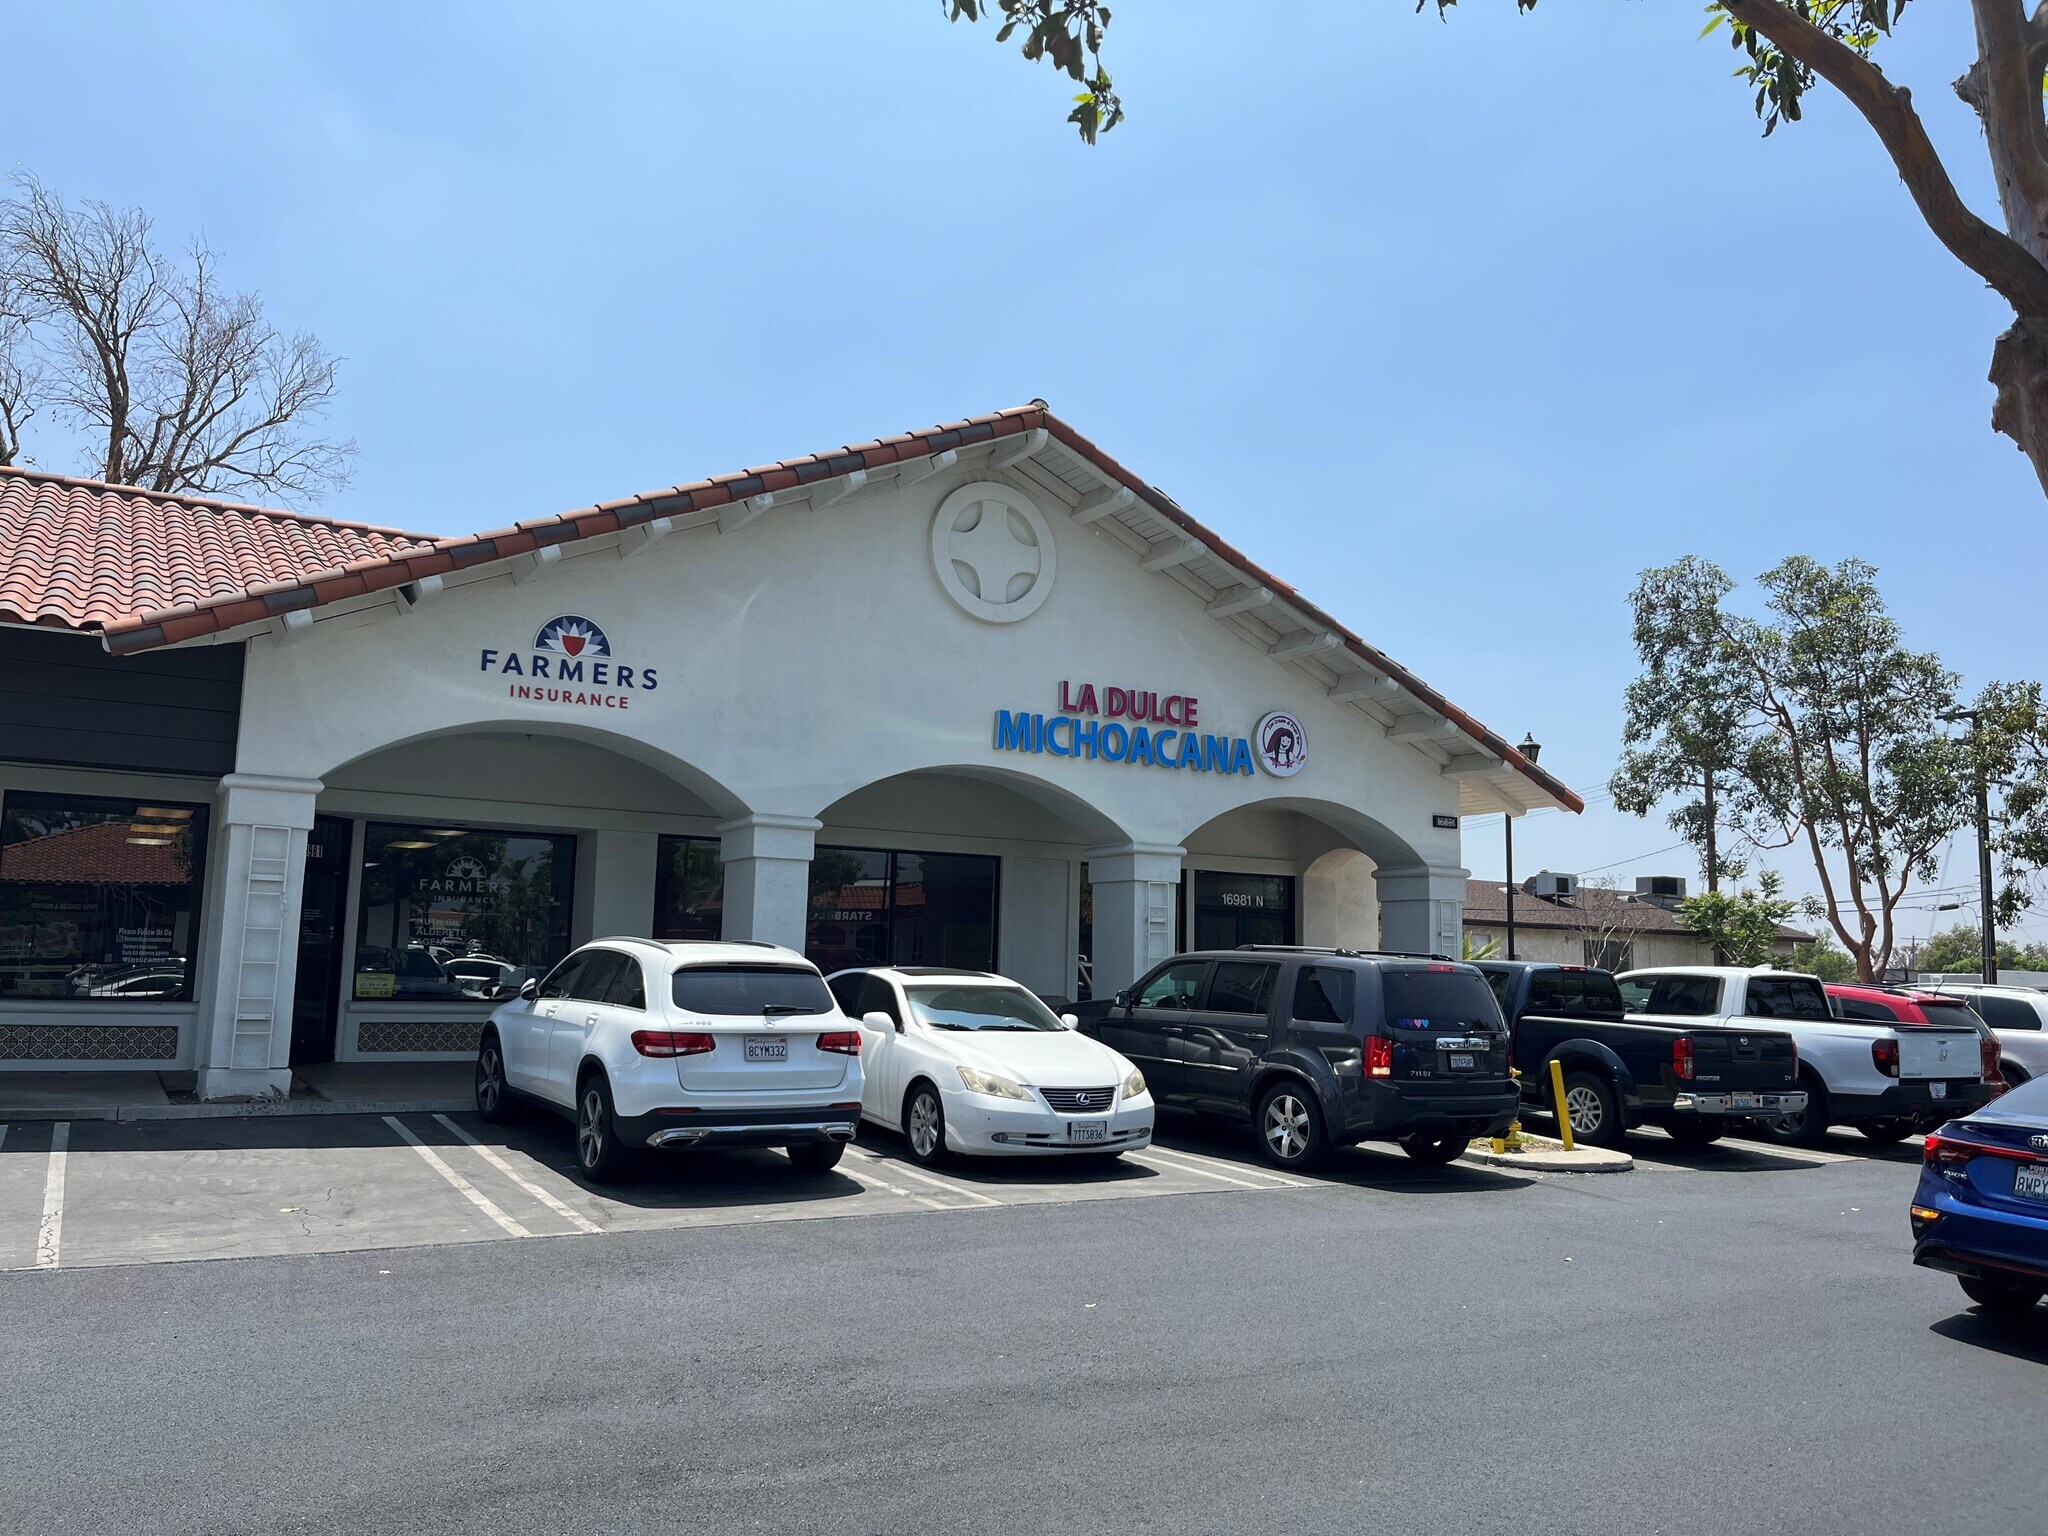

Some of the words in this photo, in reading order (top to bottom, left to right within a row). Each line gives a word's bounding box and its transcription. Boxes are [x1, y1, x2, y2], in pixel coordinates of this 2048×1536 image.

[480, 649, 658, 691] FARMERS
[510, 684, 629, 710] INSURANCE
[1058, 680, 1099, 715] LA
[1103, 686, 1199, 727] DULCE
[993, 709, 1256, 776] MICHOACANA
[419, 878, 512, 893] FARMERS
[433, 895, 496, 904] INSURANCE
[1221, 893, 1252, 906] 16981
[1255, 895, 1264, 907] N
[416, 927, 468, 937] ALDERETE
[748, 1045, 786, 1057] 8CYM332
[1073, 1129, 1103, 1140] 7TTS836
[2031, 1137, 2048, 1147] KIA
